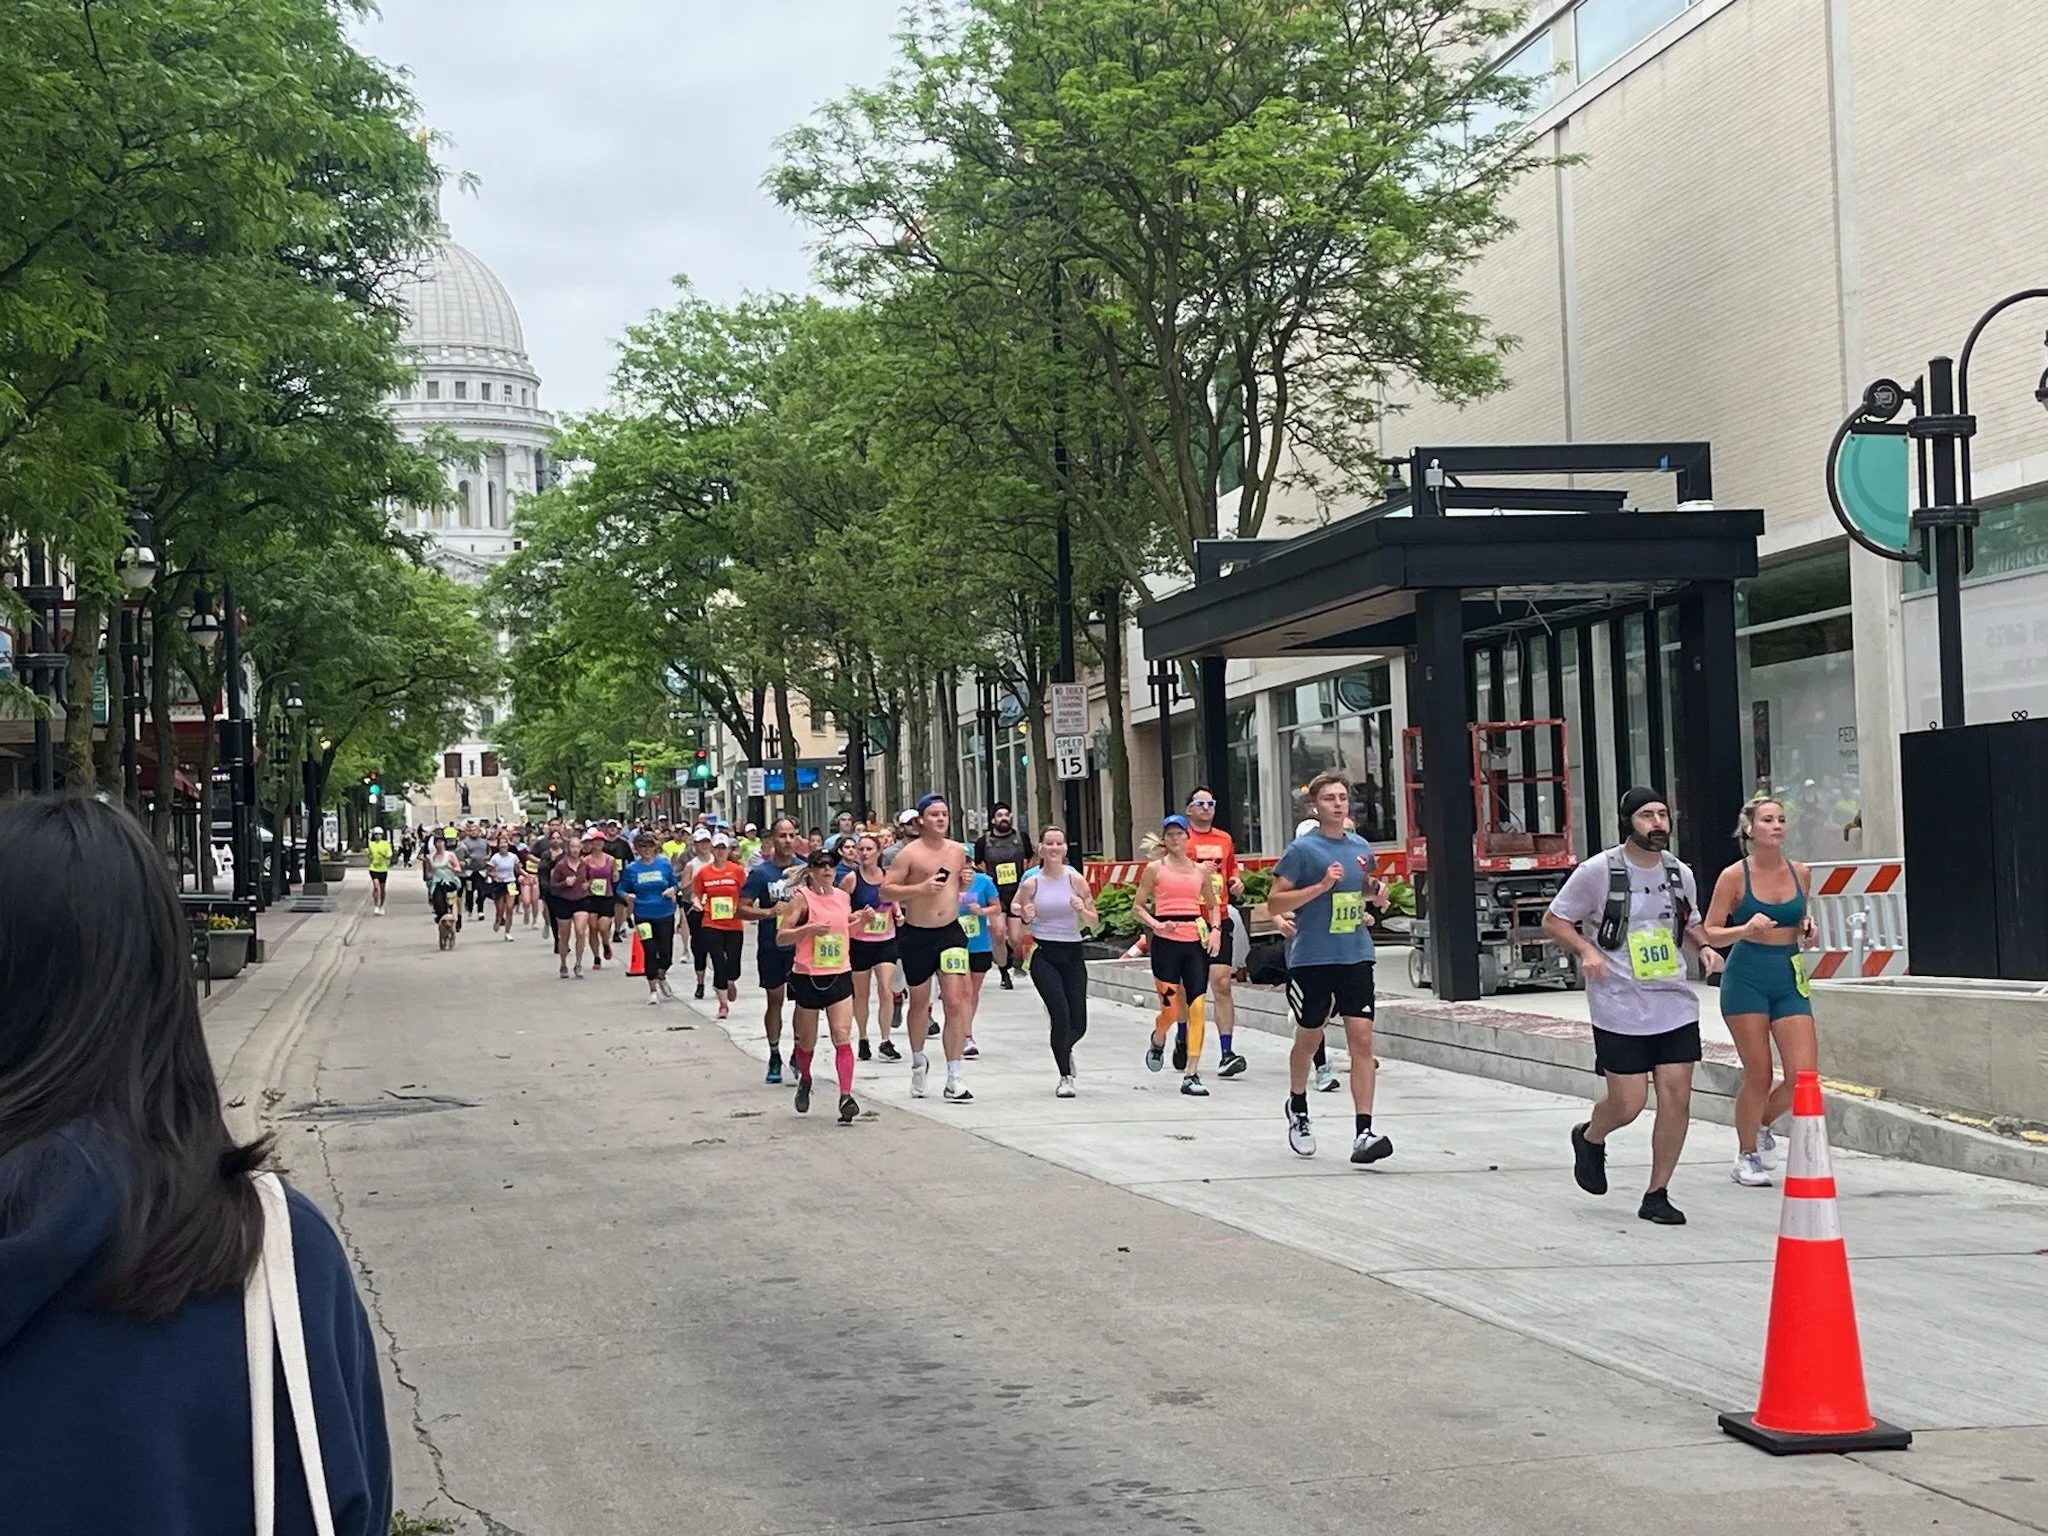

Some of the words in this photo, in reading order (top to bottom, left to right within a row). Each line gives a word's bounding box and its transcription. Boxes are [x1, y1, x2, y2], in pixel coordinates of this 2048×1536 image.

[1057, 739, 1082, 748] SPEED
[1060, 748, 1080, 756] LIMIT
[1061, 757, 1082, 775] 15
[1640, 944, 1669, 964] 360
[946, 958, 967, 969] 691
